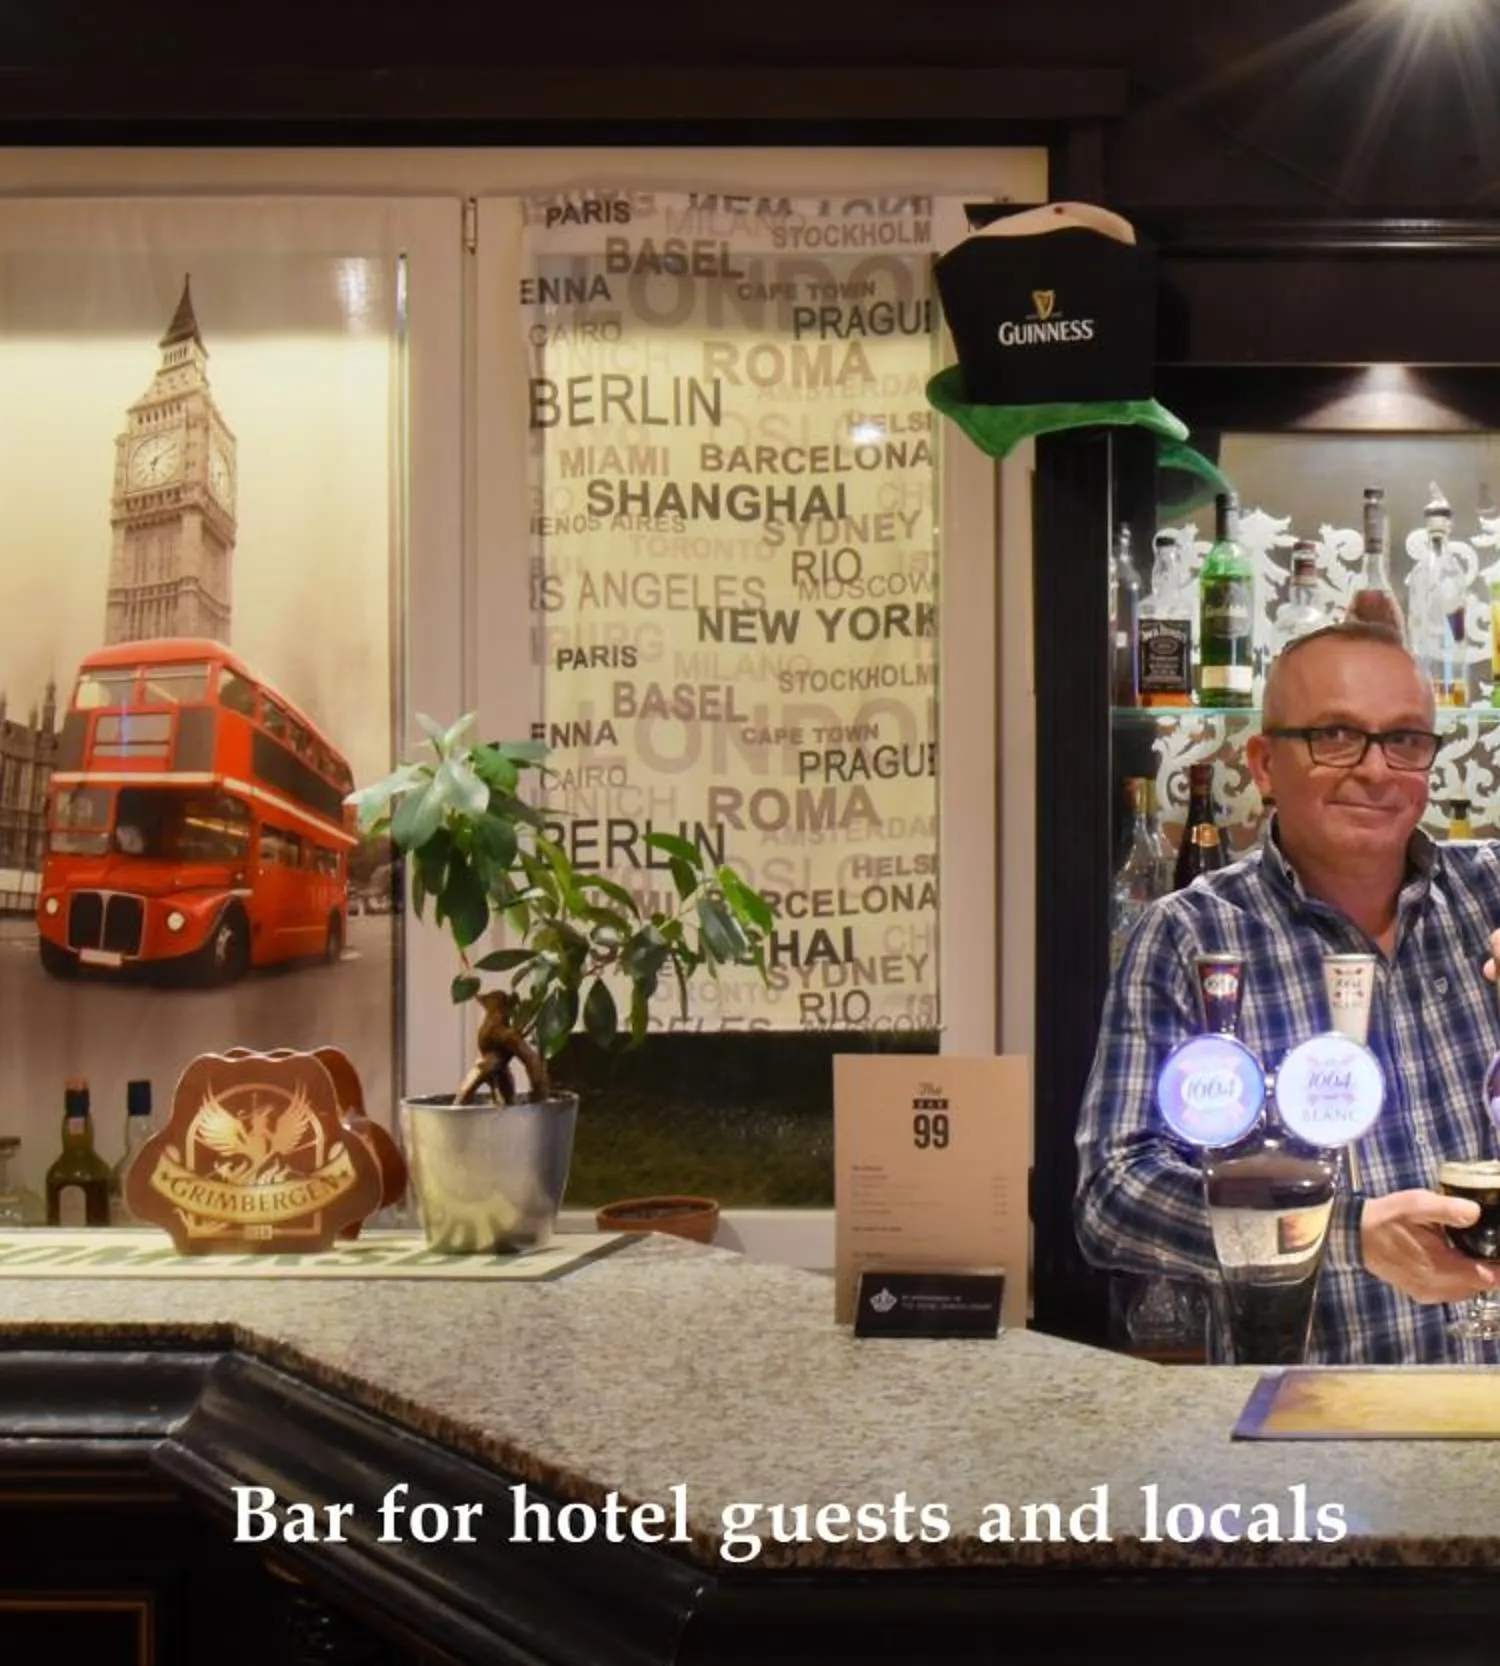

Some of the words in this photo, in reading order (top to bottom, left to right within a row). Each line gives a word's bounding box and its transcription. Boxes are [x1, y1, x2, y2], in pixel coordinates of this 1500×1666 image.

[545, 200, 632, 229] PARIS
[771, 219, 932, 248] STOCKHOLM
[605, 236, 745, 280] BASEL
[519, 273, 612, 305] ENNA
[737, 282, 797, 302] CAPE
[806, 281, 876, 299] TOWN
[528, 319, 623, 348] CAIRO
[998, 319, 1095, 346] GUINNESS
[701, 340, 876, 389] ROMA
[529, 374, 723, 430] BERLIN
[559, 444, 670, 478] MIAMI
[699, 440, 936, 476] BARCELONA
[586, 479, 848, 523] SHANGHAI
[761, 509, 922, 548] SYDNEY
[791, 547, 863, 588] RIO
[576, 570, 768, 612] ANGELES
[799, 572, 937, 601] MOSCOW
[696, 606, 800, 645] NEW
[814, 601, 938, 644] YORK
[556, 646, 638, 671] PARIS
[777, 662, 936, 695] STOCKHOLM
[611, 679, 748, 723] BASEL
[740, 726, 805, 747] CAPE
[812, 723, 881, 745] TOWN
[705, 784, 883, 832] ROMA
[705, 881, 937, 923] BRCELONA
[765, 953, 928, 992] SYDNEY
[797, 990, 871, 1024] RIO
[913, 1114, 949, 1149] 99
[170, 1173, 341, 1214] GRIMBERGEN
